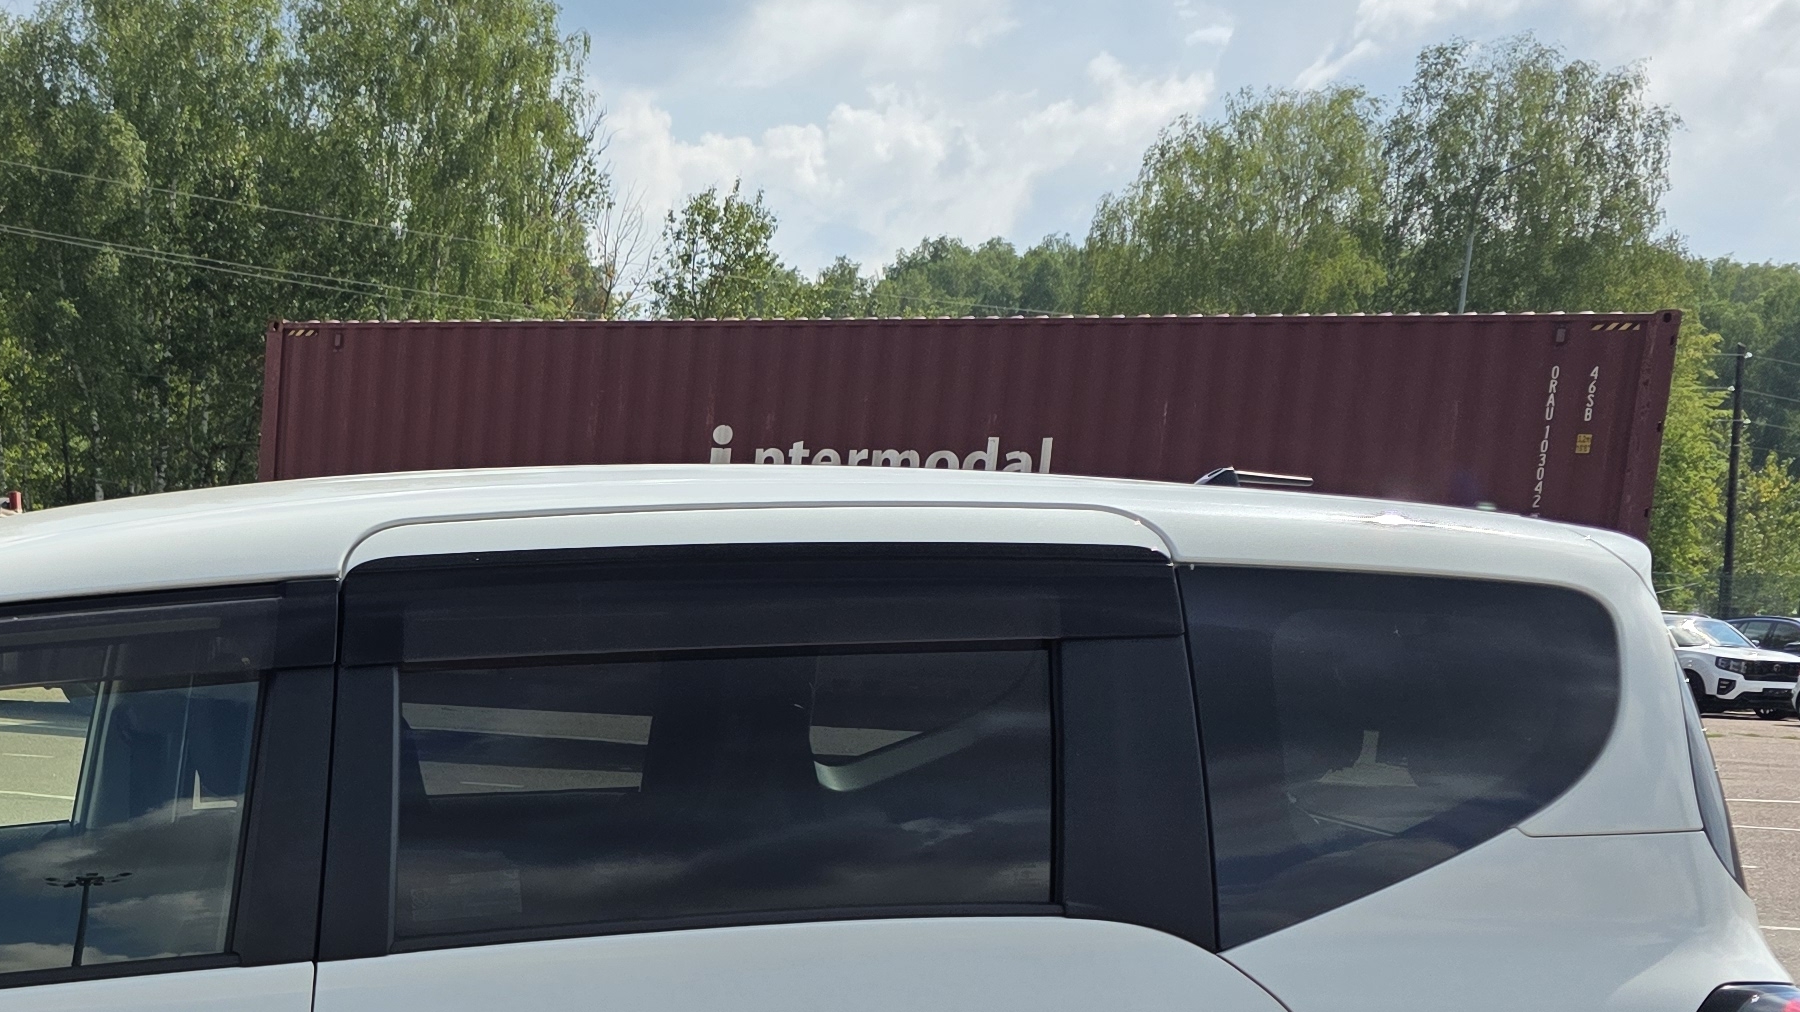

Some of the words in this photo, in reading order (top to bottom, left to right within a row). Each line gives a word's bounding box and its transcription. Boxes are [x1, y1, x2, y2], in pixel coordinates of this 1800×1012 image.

[1545, 365, 1560, 421] ORAU
[1583, 365, 1600, 422] 46SB
[1532, 424, 1550, 508] 103042
